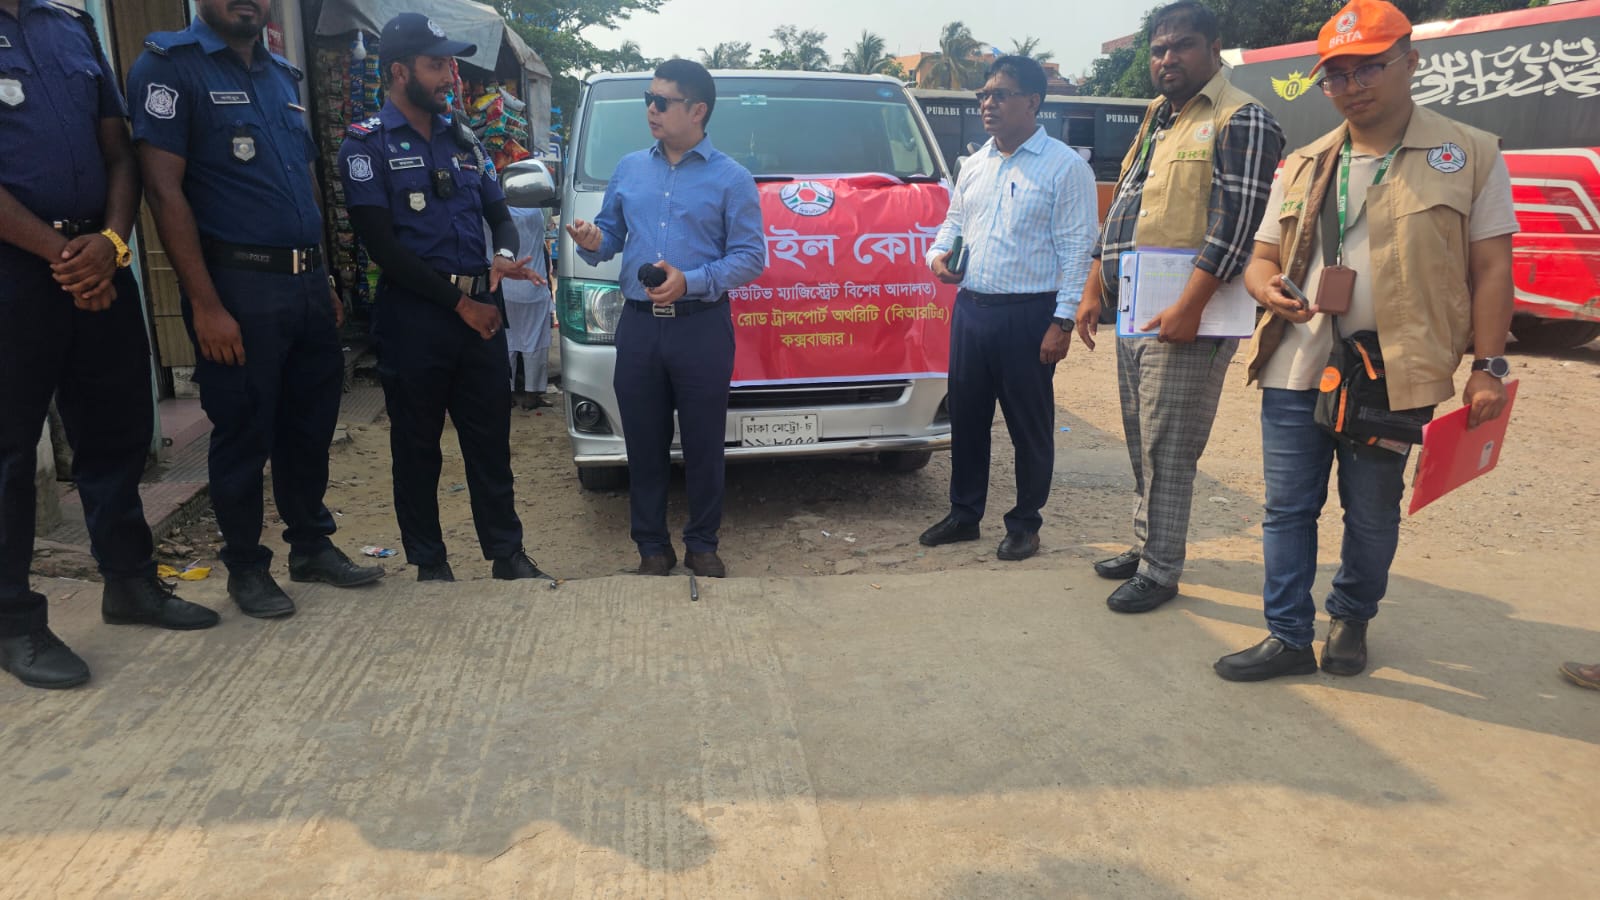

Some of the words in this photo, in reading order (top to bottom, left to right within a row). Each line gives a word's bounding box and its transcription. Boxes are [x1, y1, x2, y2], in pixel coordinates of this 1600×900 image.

[1328, 30, 1363, 49] BRTA
[926, 106, 960, 116] PURABI
[1105, 113, 1139, 124] PURABI
[843, 281, 880, 298] বিশেষ
[737, 312, 768, 327] রোড
